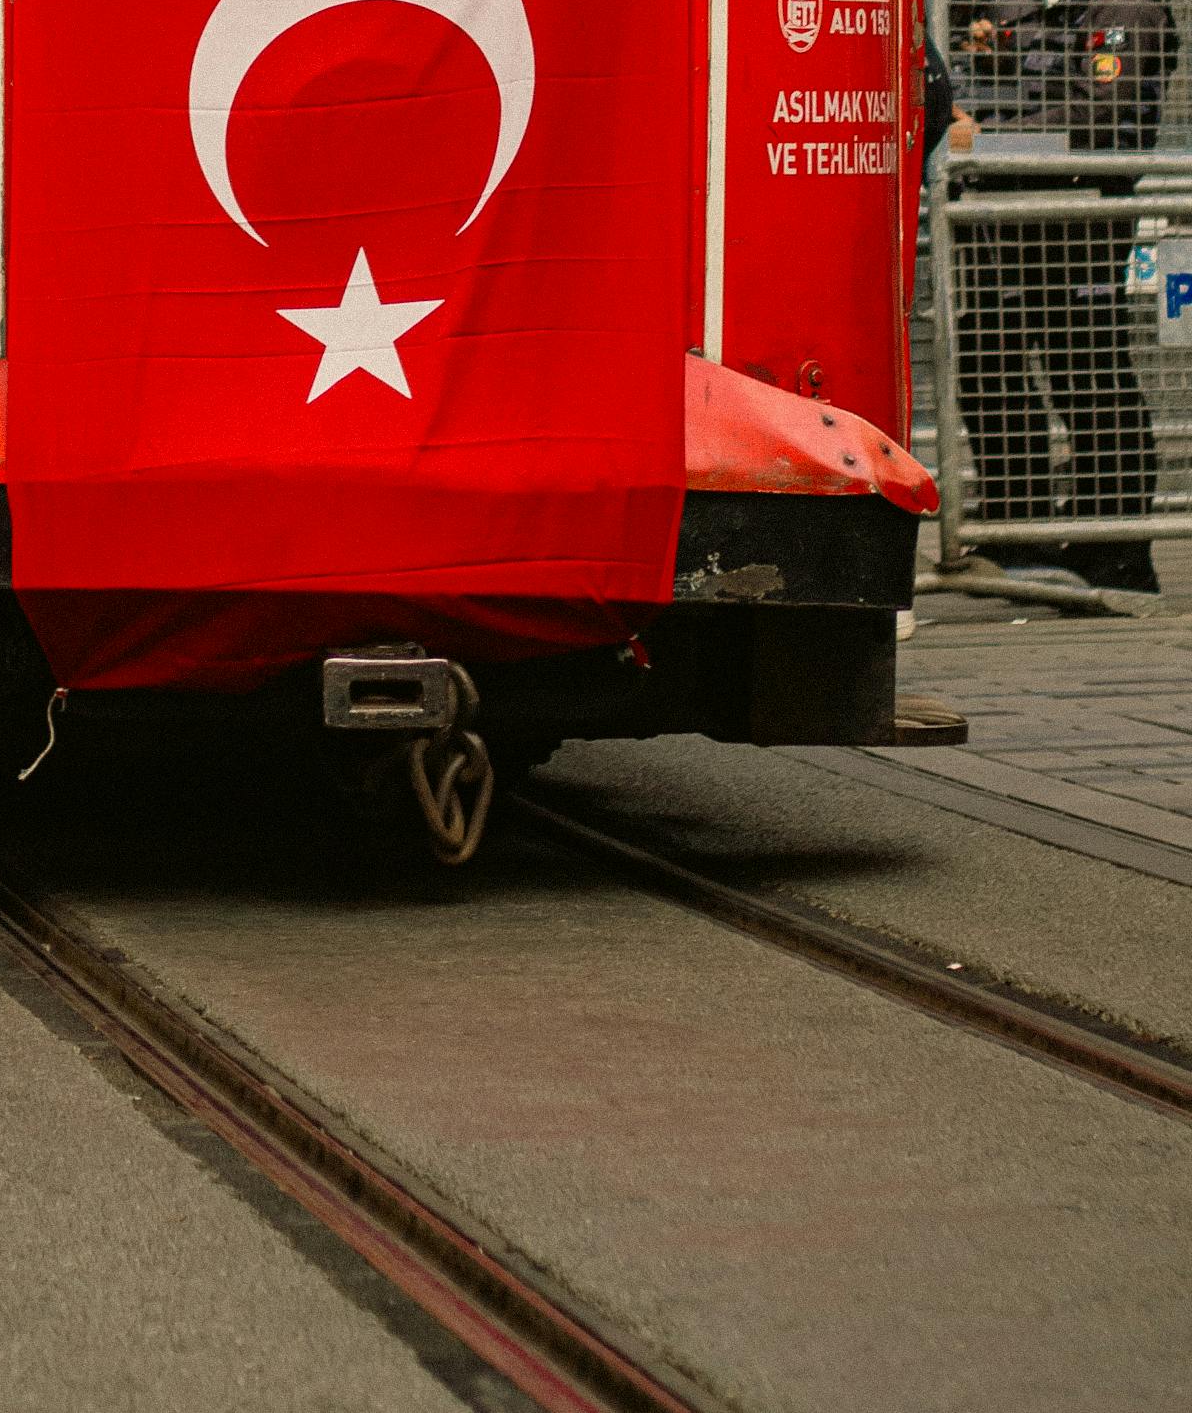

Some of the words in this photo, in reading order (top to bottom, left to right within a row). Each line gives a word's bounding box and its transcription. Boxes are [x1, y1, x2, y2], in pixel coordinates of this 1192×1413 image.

[829, 8, 867, 35] ALO
[871, 9, 890, 36] 153
[773, 90, 863, 123] ASILMAK
[767, 142, 797, 175] VE
